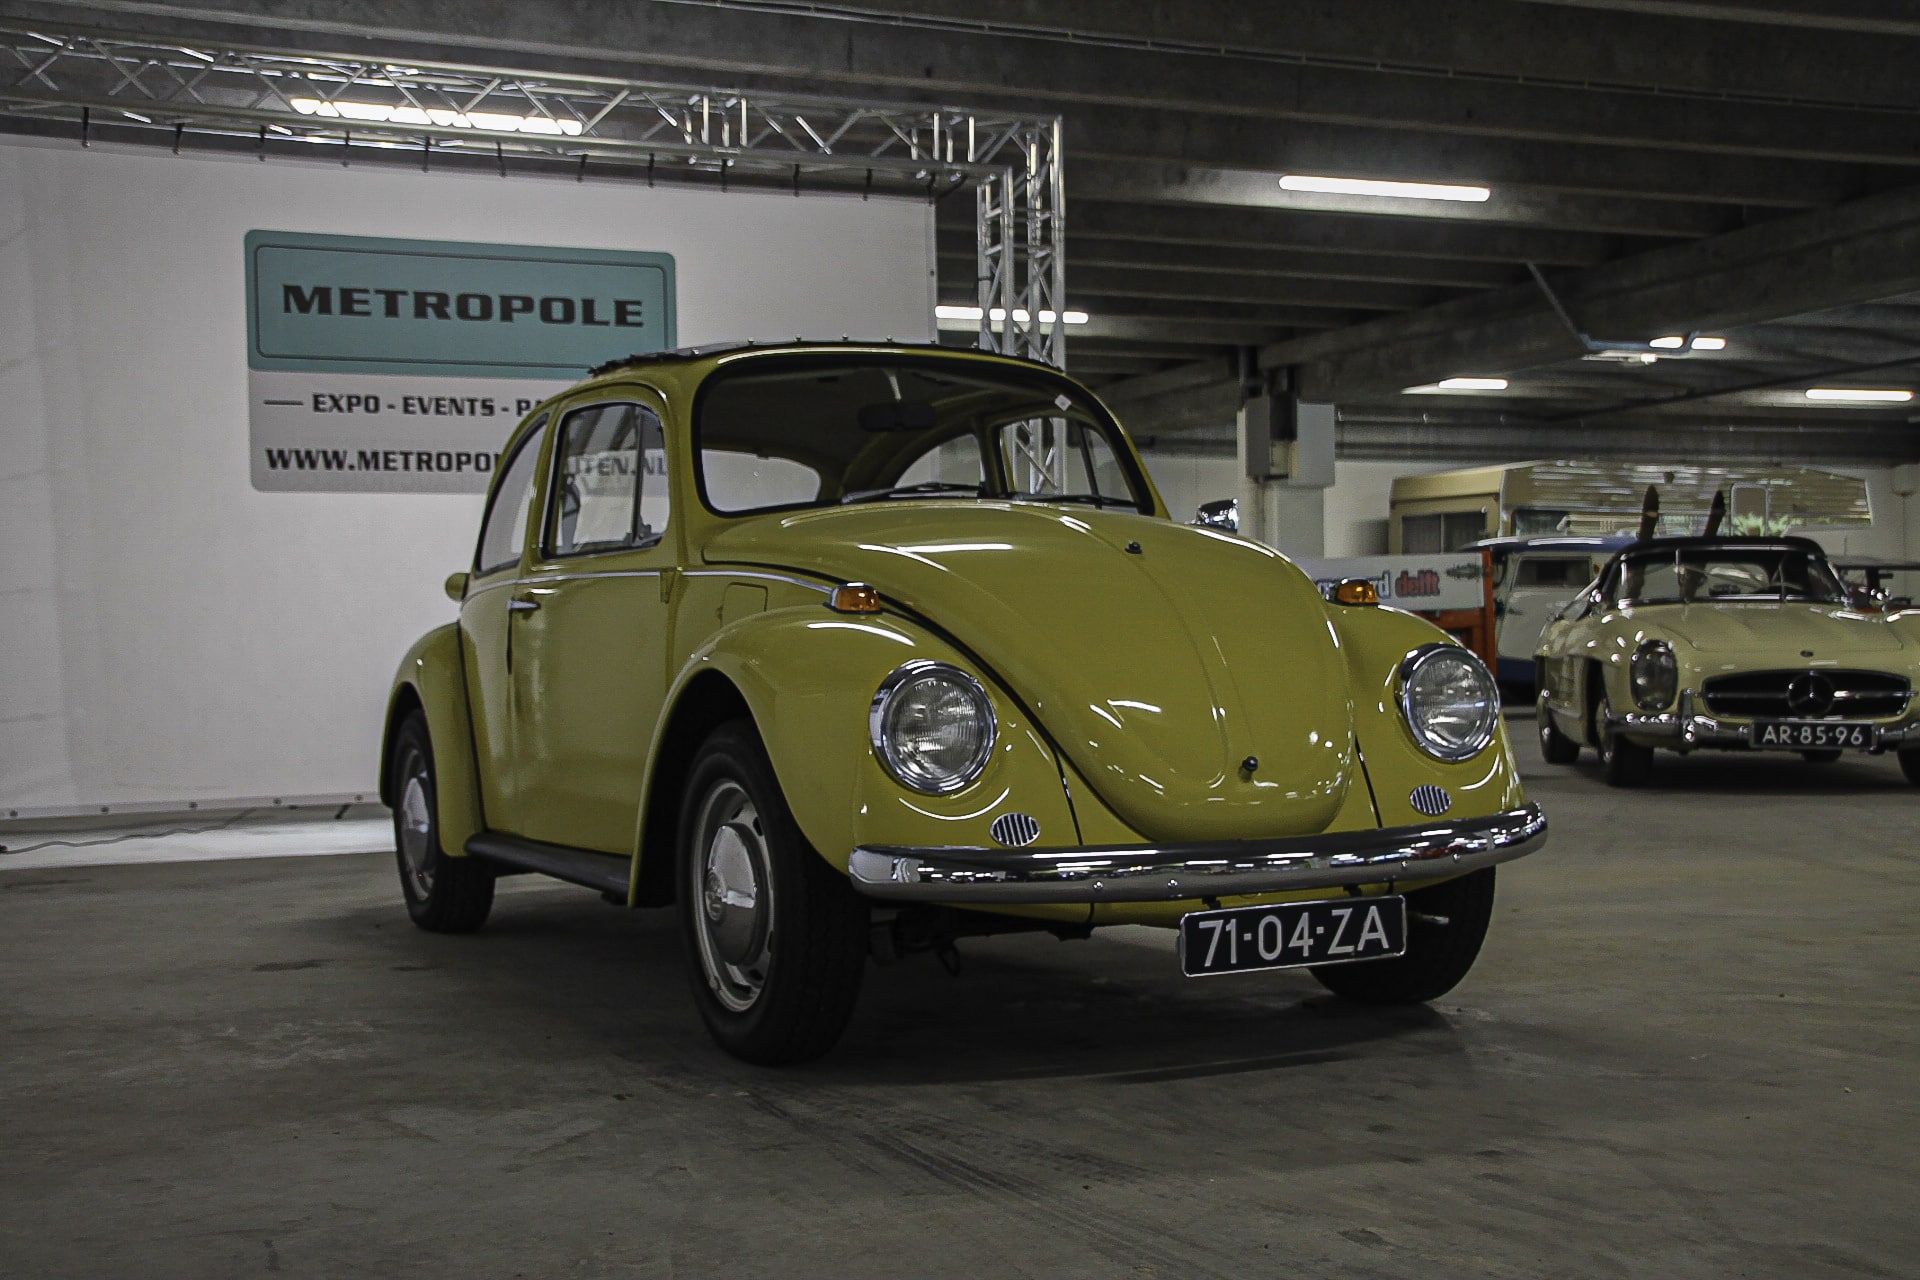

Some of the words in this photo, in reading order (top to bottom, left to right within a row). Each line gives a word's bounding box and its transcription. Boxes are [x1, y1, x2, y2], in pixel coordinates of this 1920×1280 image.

[282, 283, 645, 328] METROPOLE
[312, 392, 381, 414] EXPO
[402, 395, 495, 417] EVENTS
[1395, 569, 1440, 598] delft
[1198, 904, 1390, 967] 71-04-ZA
